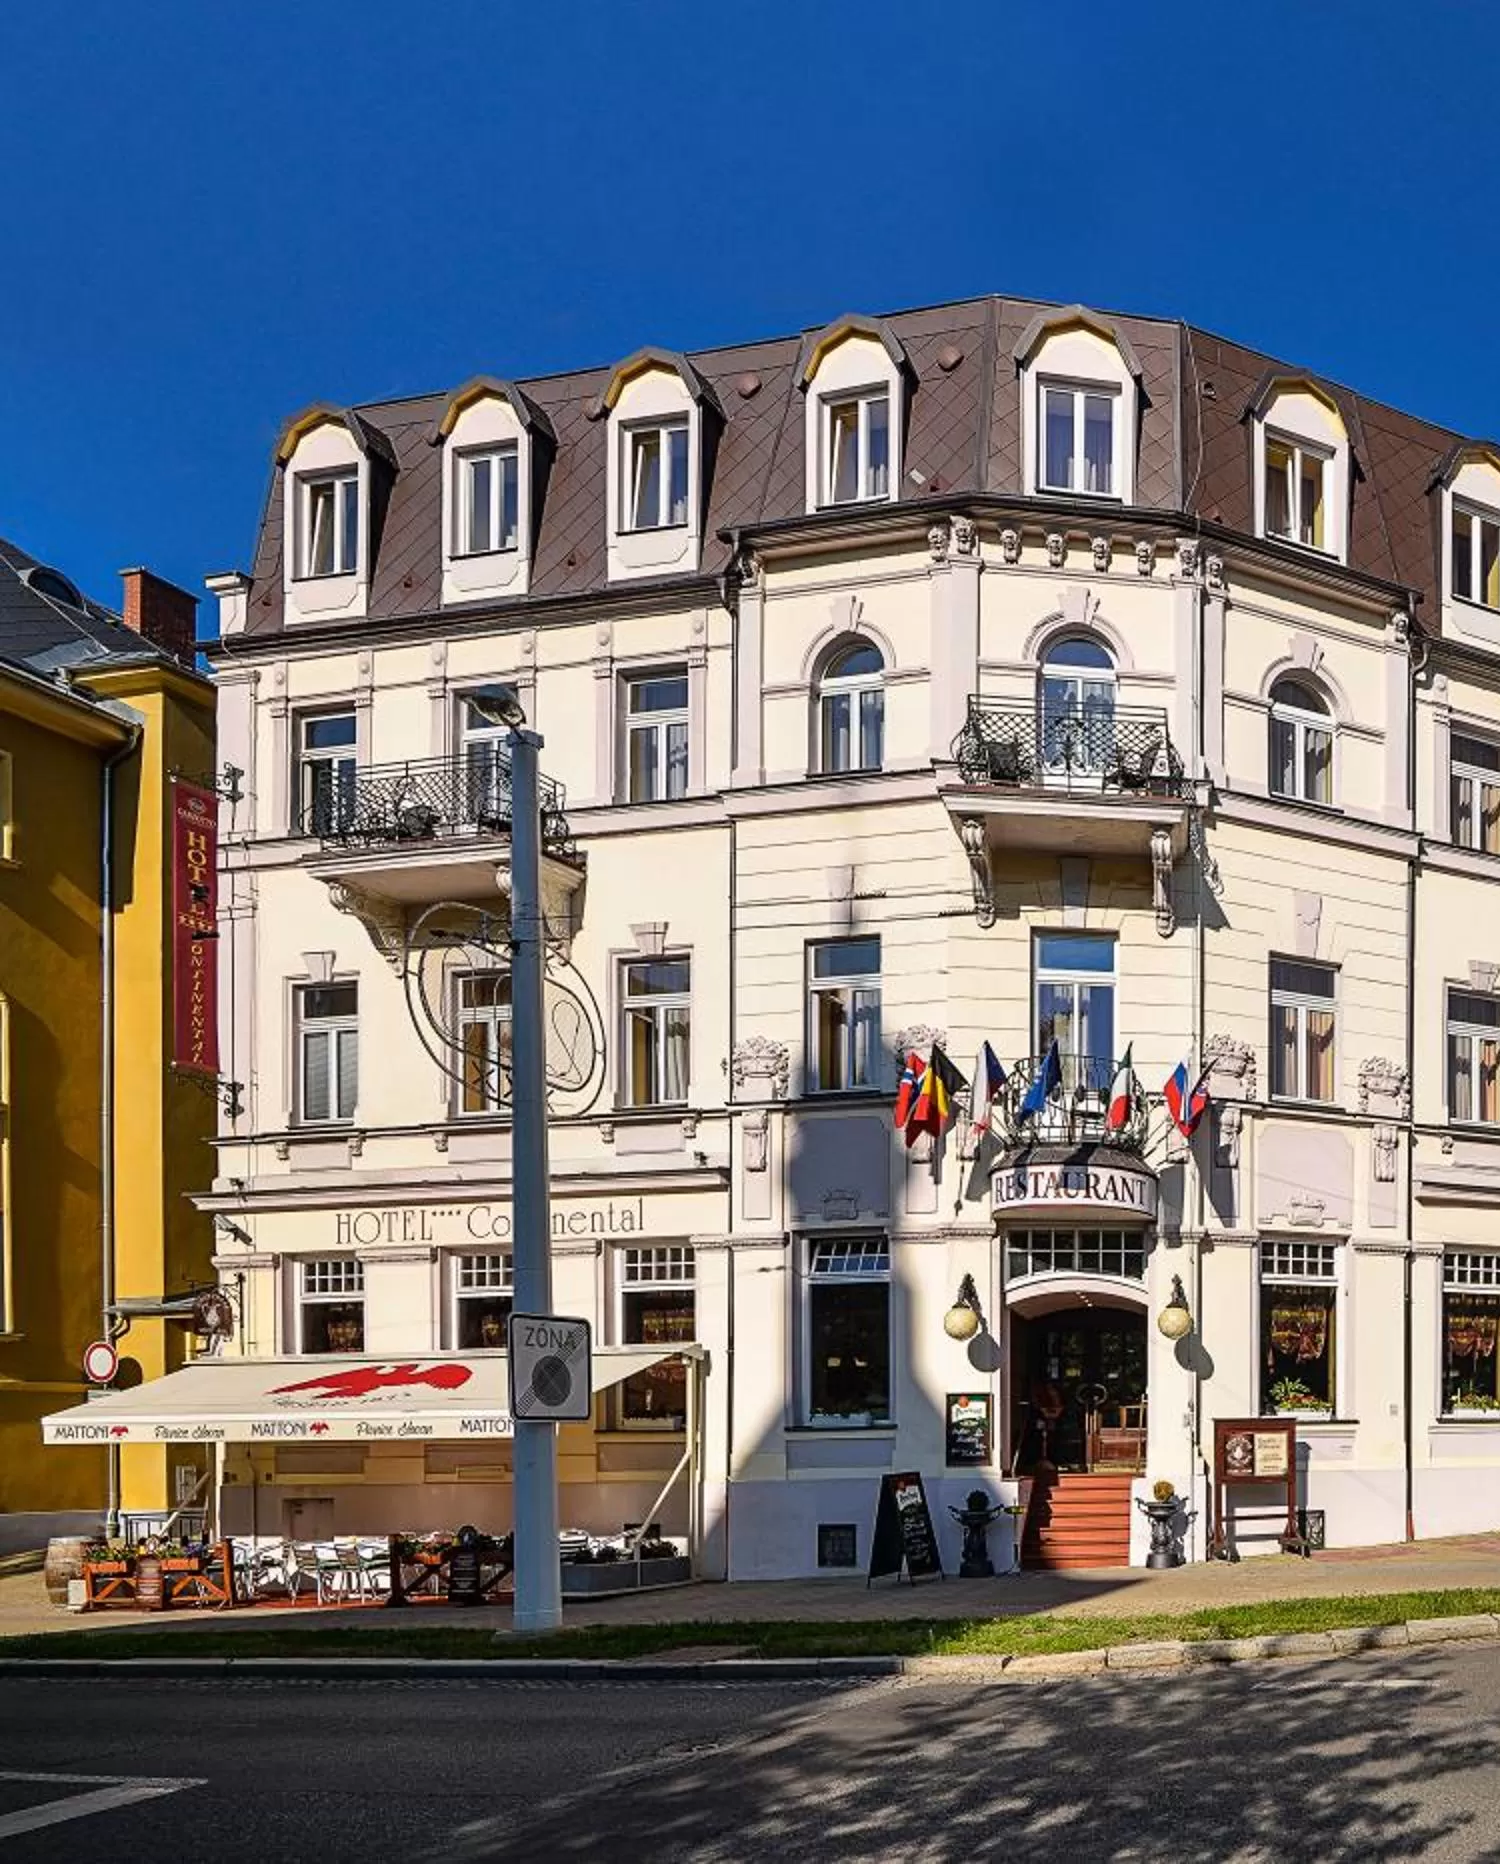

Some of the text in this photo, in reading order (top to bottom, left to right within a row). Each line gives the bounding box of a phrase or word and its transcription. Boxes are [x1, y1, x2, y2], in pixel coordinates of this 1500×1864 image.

[187, 830, 207, 914] HOTL
[190, 942, 205, 1065] ONTINENTAL
[995, 1170, 1148, 1206] RESTAURANT
[335, 1197, 645, 1245] HOTEL Conental
[54, 1425, 109, 1439] MATTONI
[251, 1422, 307, 1437] MATTONI
[459, 1418, 515, 1434] MATTON
